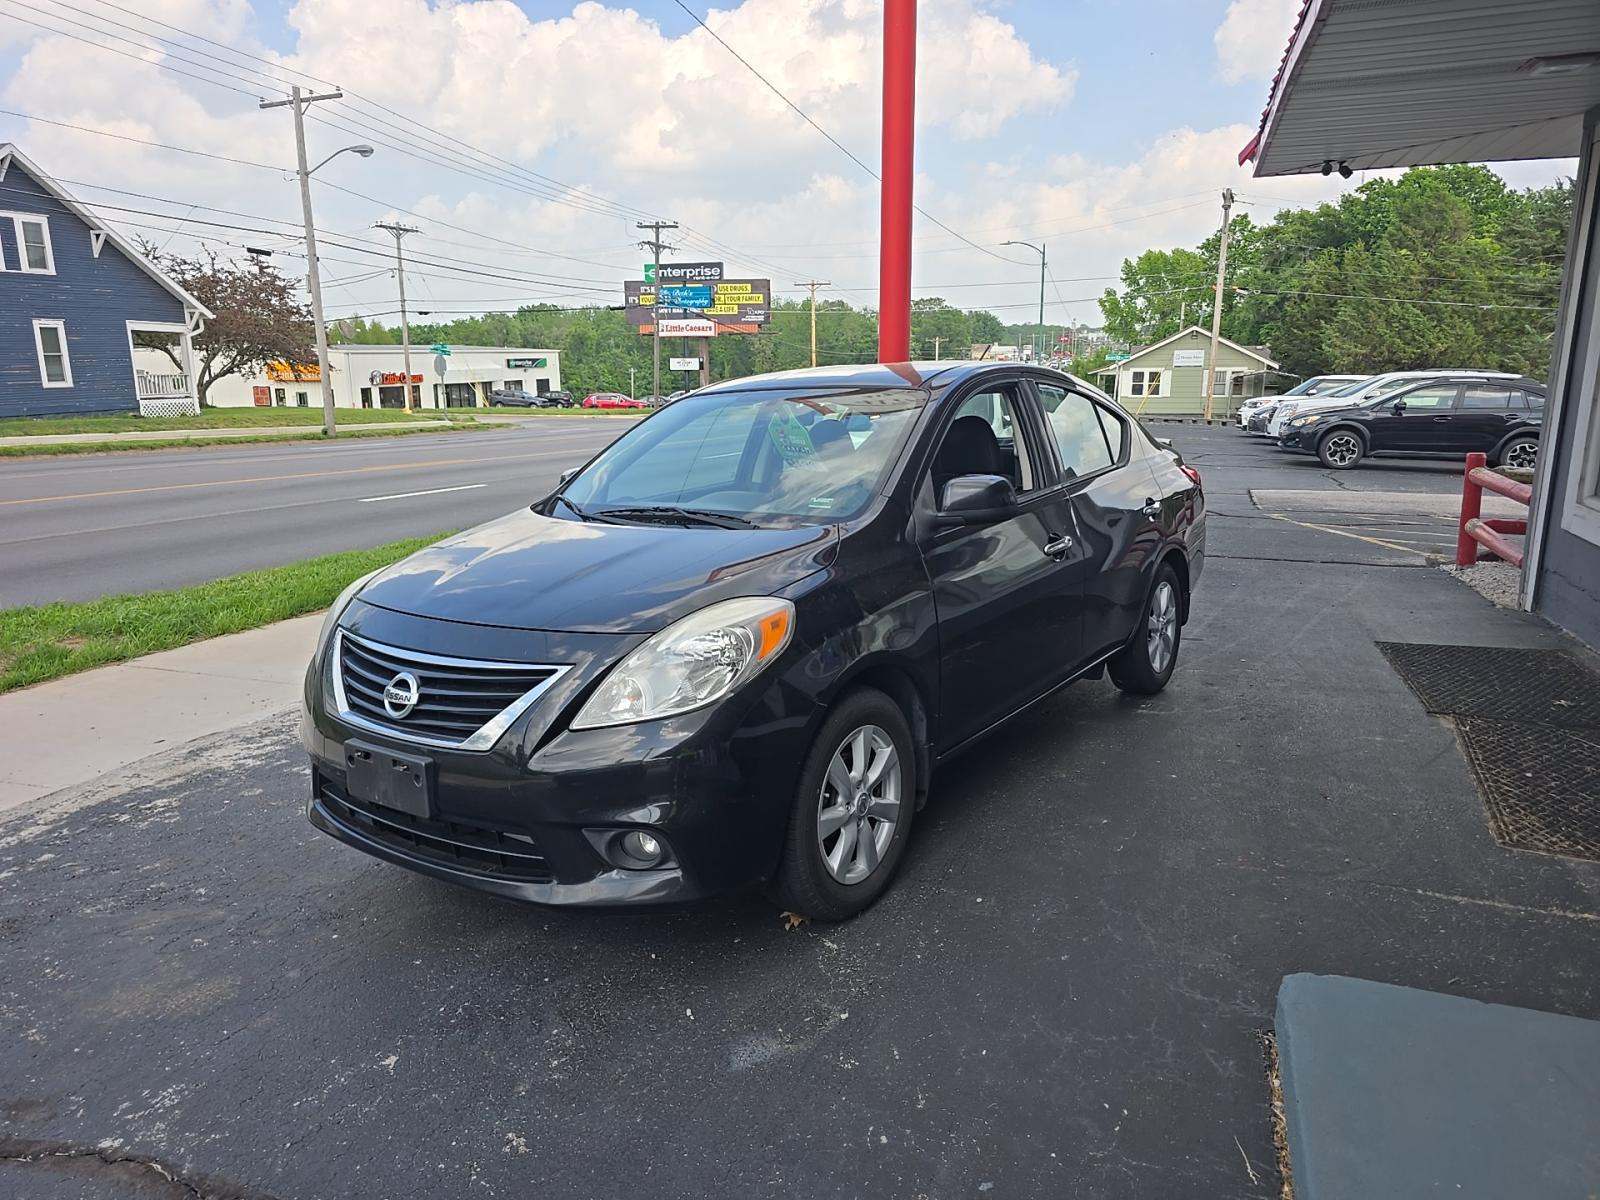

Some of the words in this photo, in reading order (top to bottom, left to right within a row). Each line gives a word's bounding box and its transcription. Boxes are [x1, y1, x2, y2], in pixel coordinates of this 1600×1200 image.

[649, 266, 720, 279] enterprise
[665, 324, 684, 332] Little
[685, 324, 712, 332] Caesars
[385, 689, 411, 703] NISSAN
